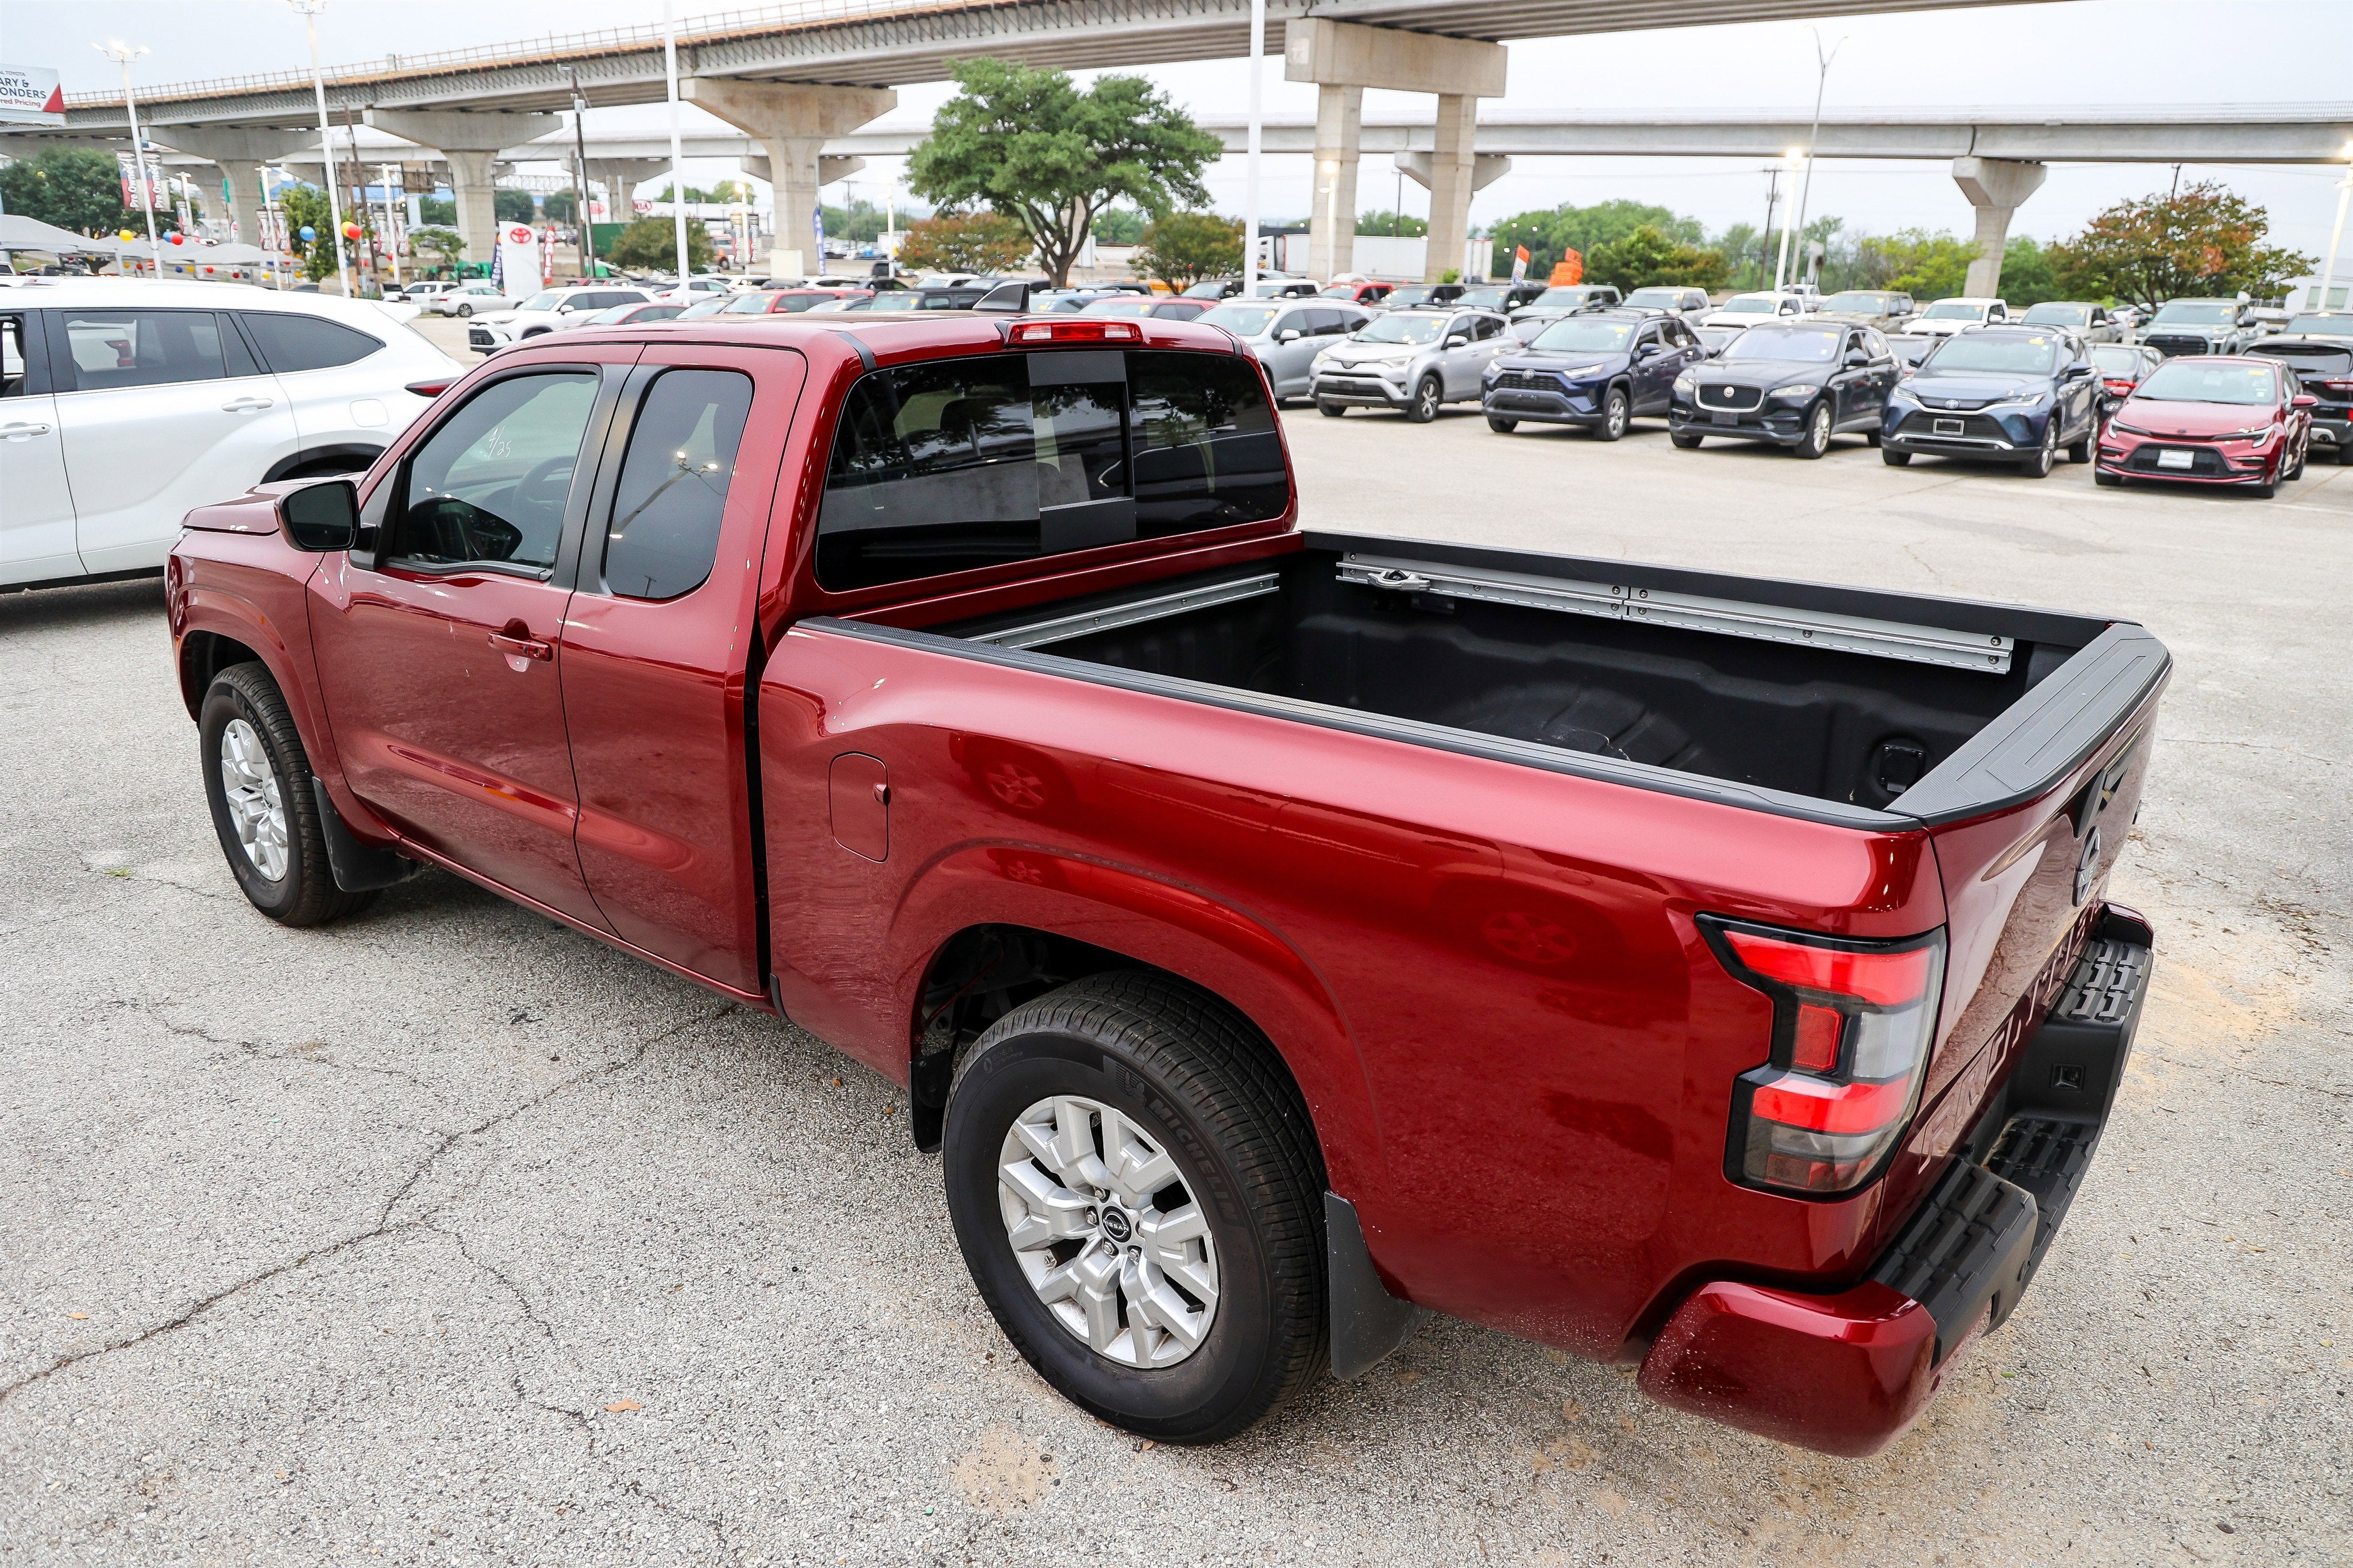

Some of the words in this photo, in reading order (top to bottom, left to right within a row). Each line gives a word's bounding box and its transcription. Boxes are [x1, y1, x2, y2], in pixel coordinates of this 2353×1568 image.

[22, 79, 29, 87] &
[0, 87, 47, 99] ONDERS
[14, 99, 41, 108] Pricing
[129, 194, 138, 208] Pre
[154, 194, 164, 208] Pre
[544, 230, 554, 280] SALE
[488, 425, 512, 460] 4/25
[246, 709, 278, 773] MICHELIN
[1148, 1099, 1239, 1222] MICHELIN
[1102, 1218, 1129, 1232] NISSAN
